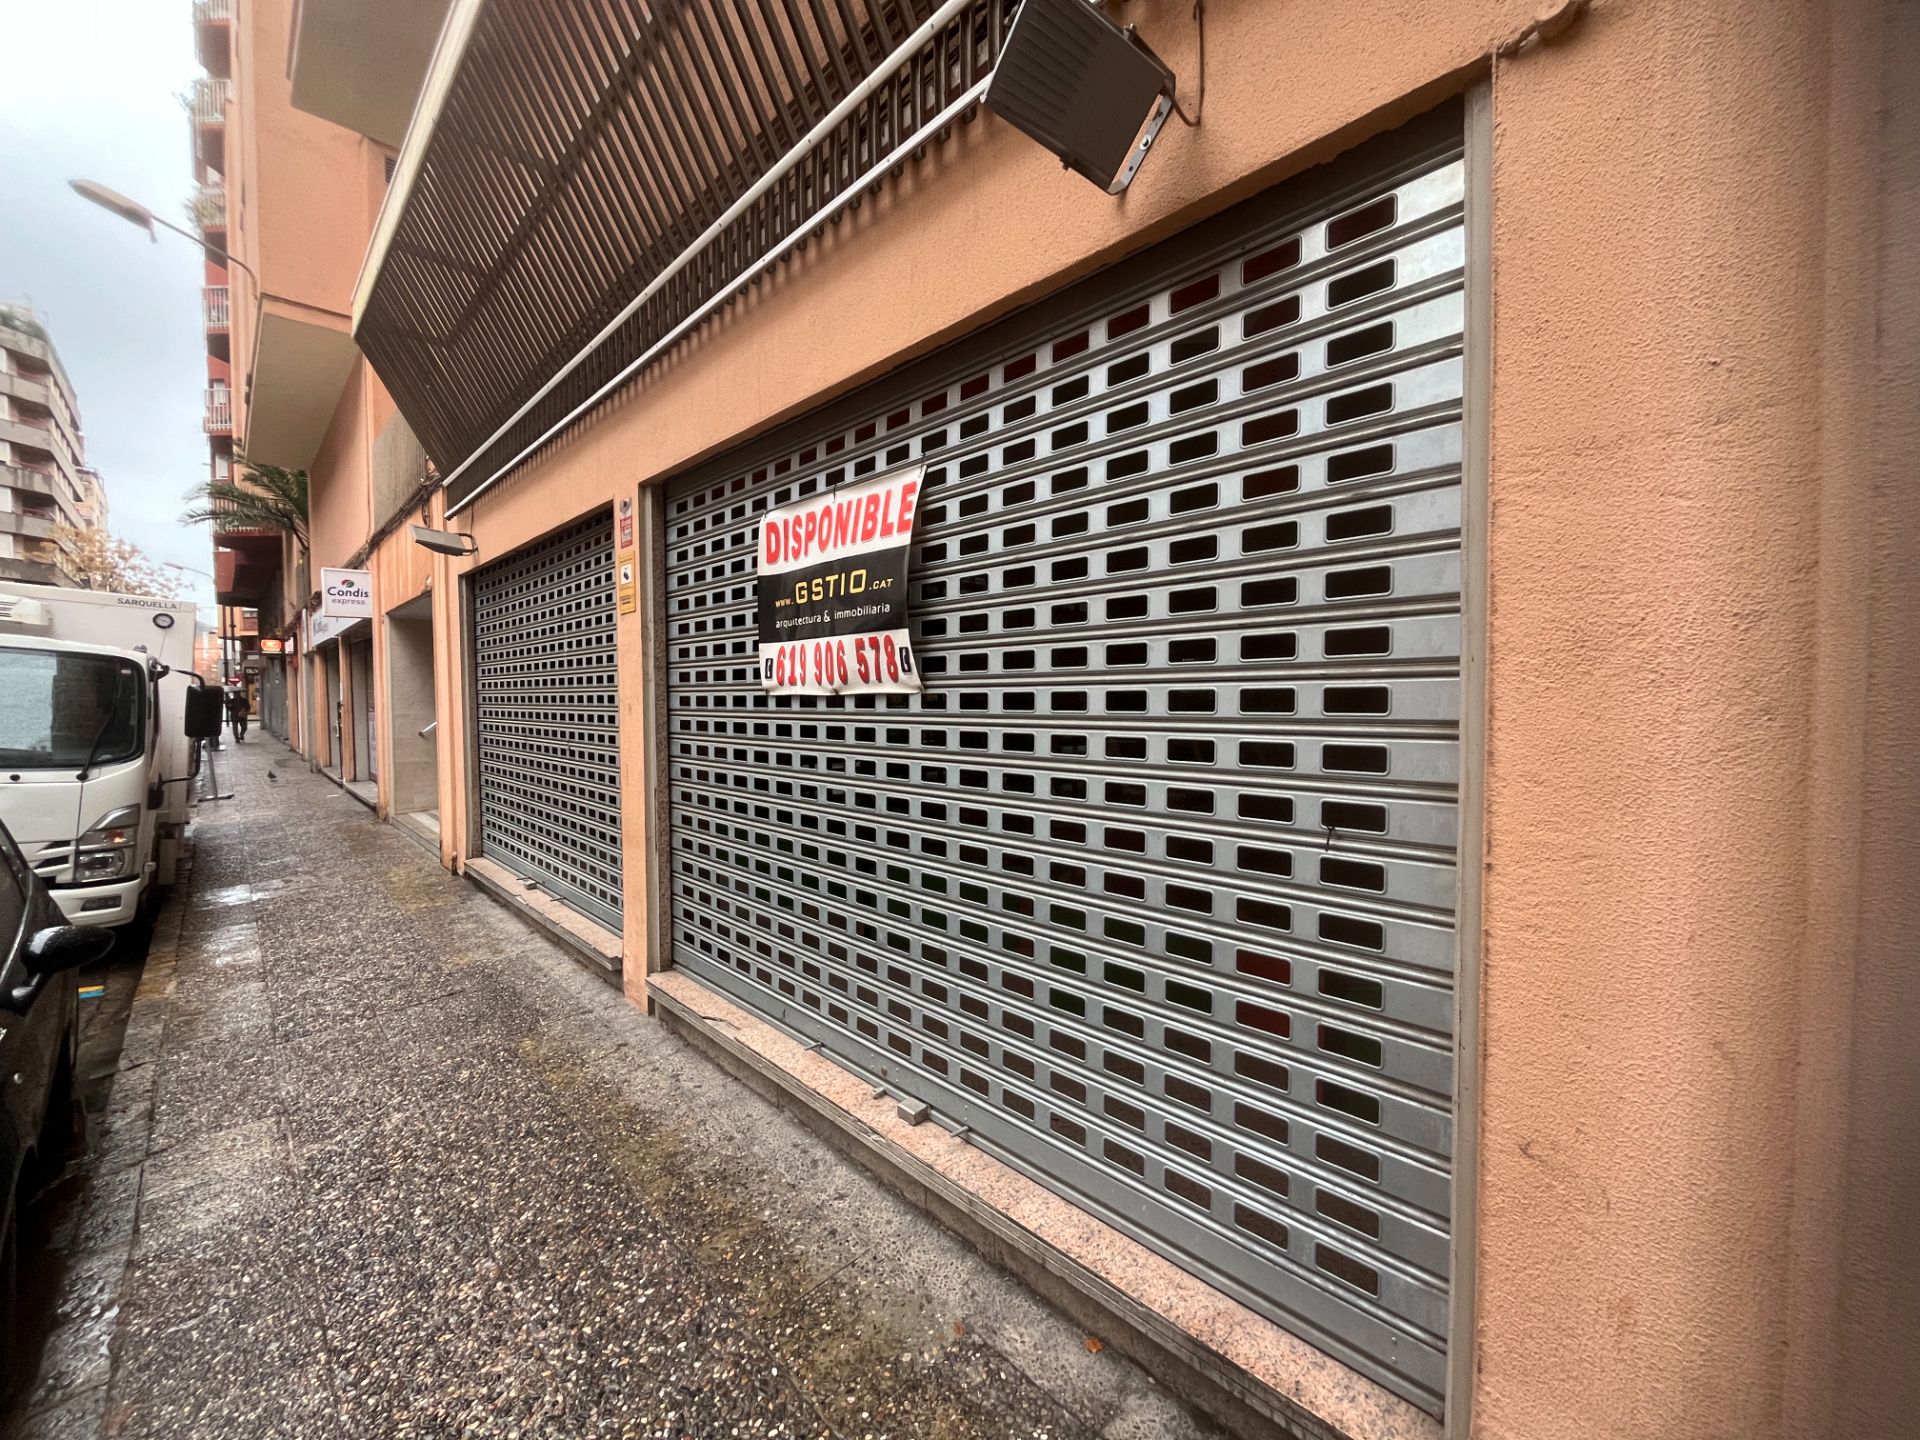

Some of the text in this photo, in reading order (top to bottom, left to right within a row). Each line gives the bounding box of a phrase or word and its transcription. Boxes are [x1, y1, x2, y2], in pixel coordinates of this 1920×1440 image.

[766, 481, 918, 566] DISPONIBLE
[117, 597, 177, 609] SARQUELLA
[327, 586, 369, 598] Condis
[775, 602, 891, 629] arquitectura & immobiliaria
[776, 634, 899, 687] 619 906 578
